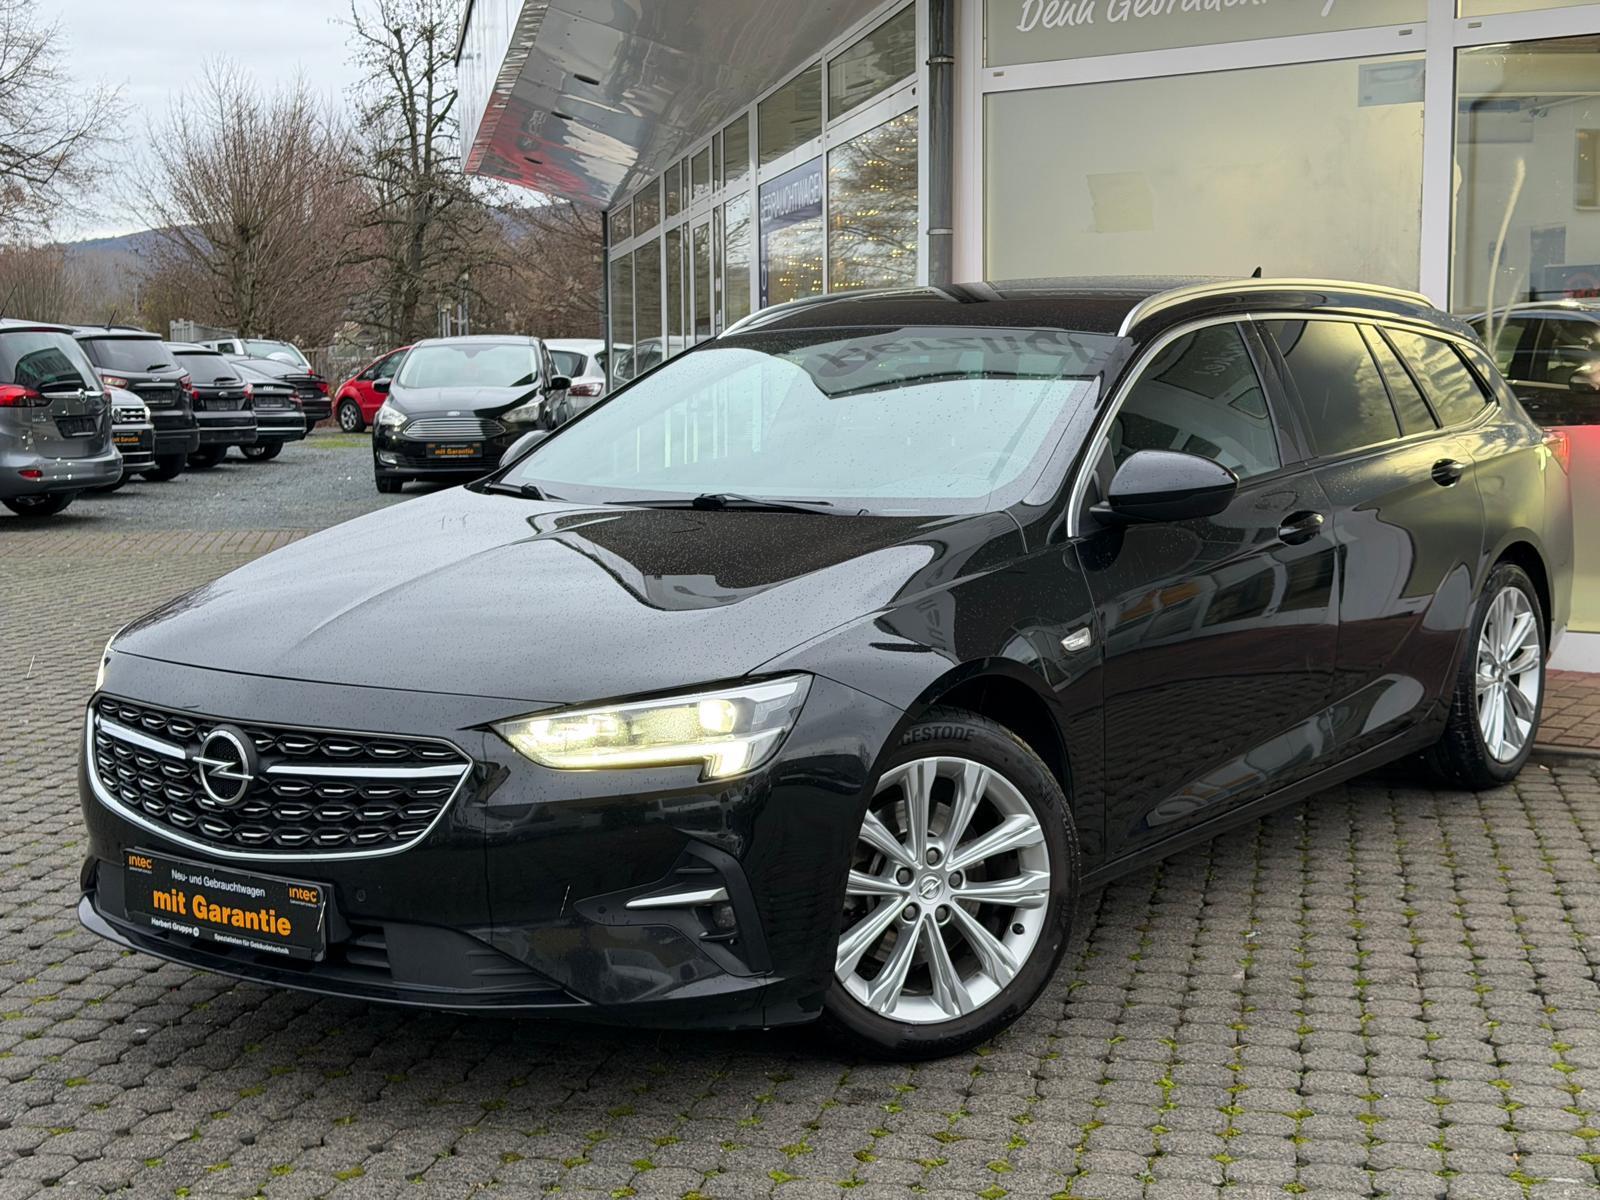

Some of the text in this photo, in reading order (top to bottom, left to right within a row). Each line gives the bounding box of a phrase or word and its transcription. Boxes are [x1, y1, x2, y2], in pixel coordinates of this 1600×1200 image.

[128, 855, 154, 869] intec
[171, 868, 266, 898] Neu- und Gebrauchtwagen
[289, 887, 318, 903] intec
[153, 888, 292, 936] mit Garantie
